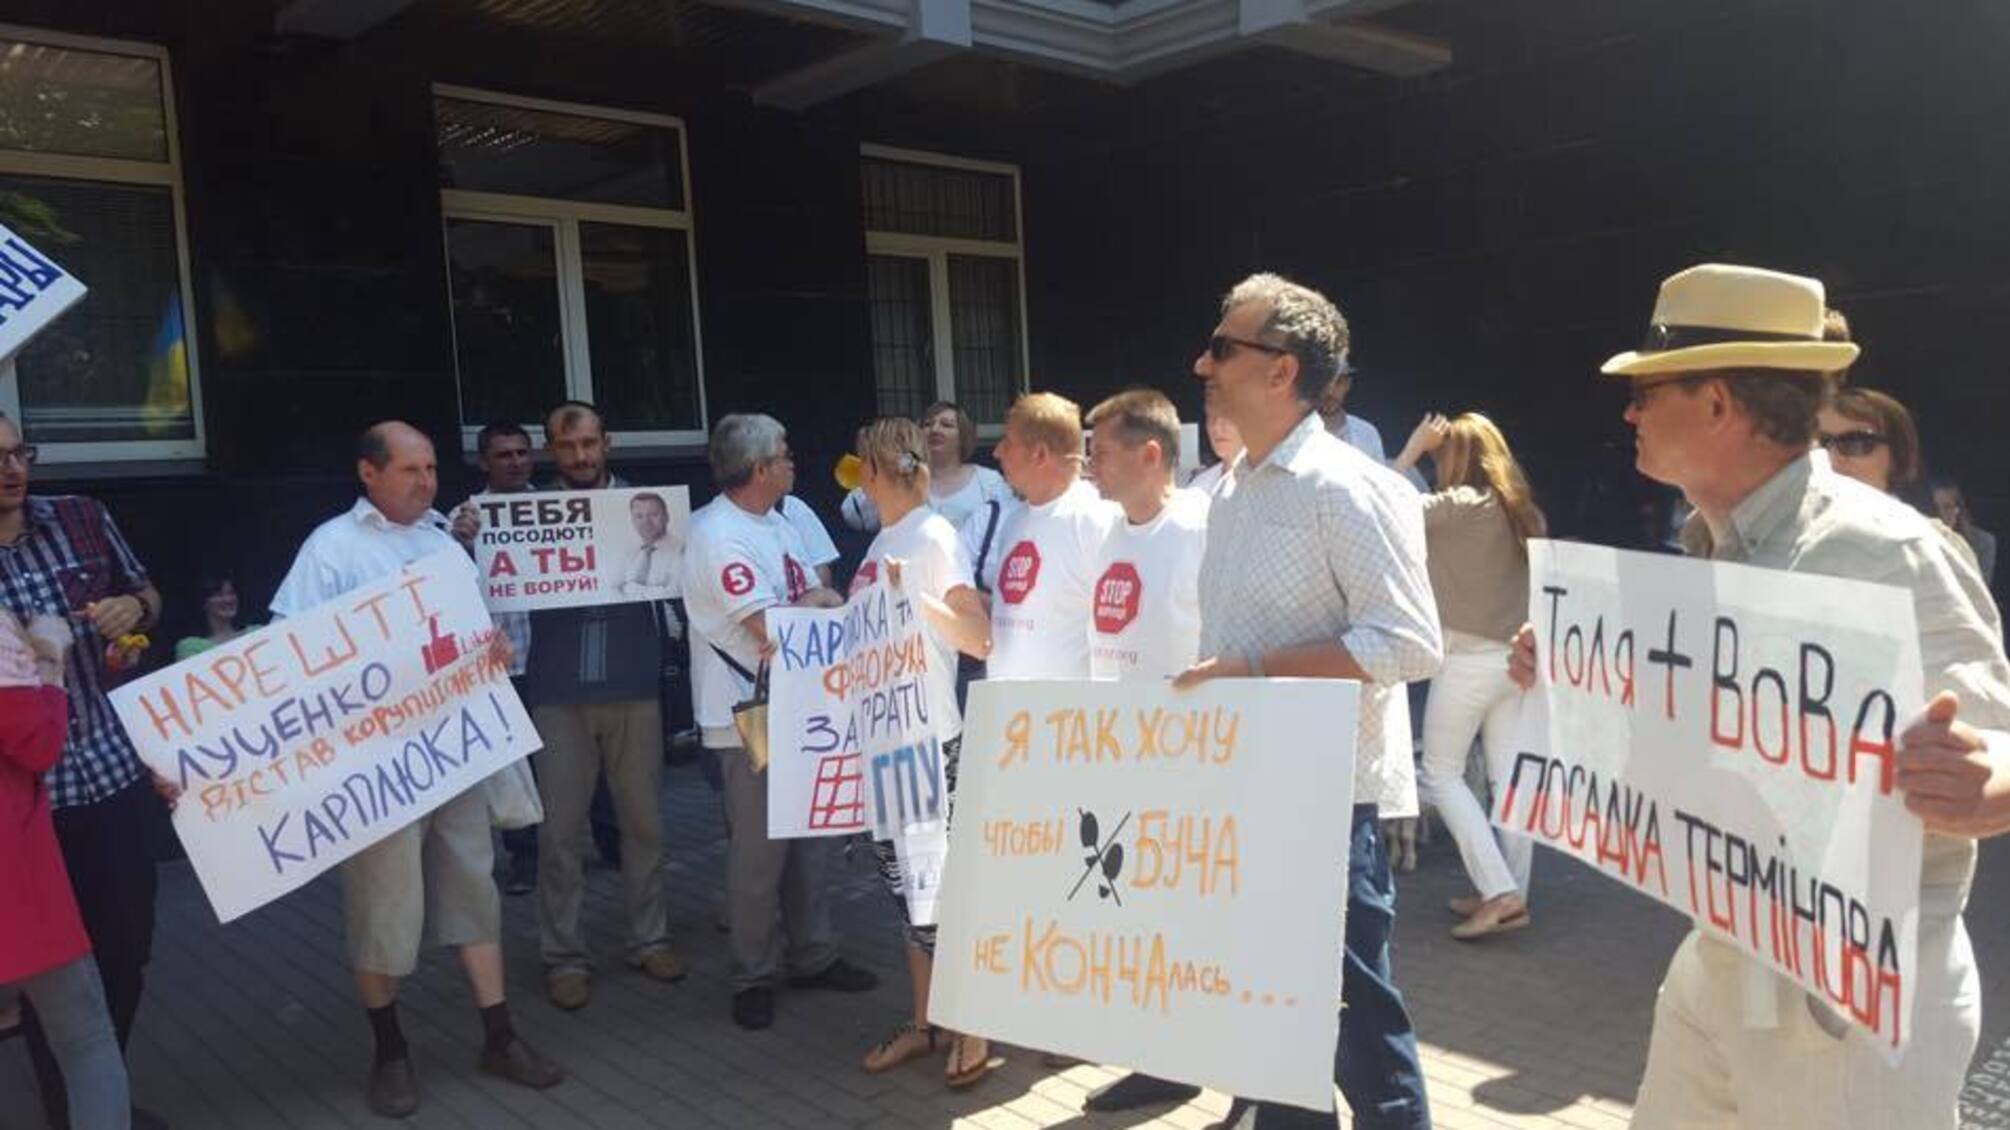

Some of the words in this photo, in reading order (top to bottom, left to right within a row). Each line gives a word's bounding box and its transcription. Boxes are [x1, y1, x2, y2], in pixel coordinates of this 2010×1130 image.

[480, 497, 592, 528] ТЕБЯ
[482, 526, 594, 545] ПОСОДЮТ!
[488, 550, 518, 578] А
[530, 545, 597, 575] ТЫ
[728, 567, 749, 591] 5
[488, 583, 517, 598] НЕ
[524, 578, 599, 597] ВОРУЙ!
[1100, 579, 1133, 605] STOP
[138, 570, 438, 742] НАРЕШТІ
[177, 662, 392, 790] ЛУЦЕНКО
[801, 711, 859, 753] ЗА
[998, 707, 1032, 770] Я
[1045, 705, 1123, 763] ТАК
[1134, 703, 1242, 766] ХОЧУ
[871, 737, 941, 826] ГПУ
[983, 817, 1066, 857] ЧТОБЫ
[1130, 808, 1242, 899] БУЧА
[1501, 752, 1669, 898] ПОСАДКА
[1674, 808, 1901, 1049] ТЕРМІНОВА
[974, 933, 1013, 974] НЕ
